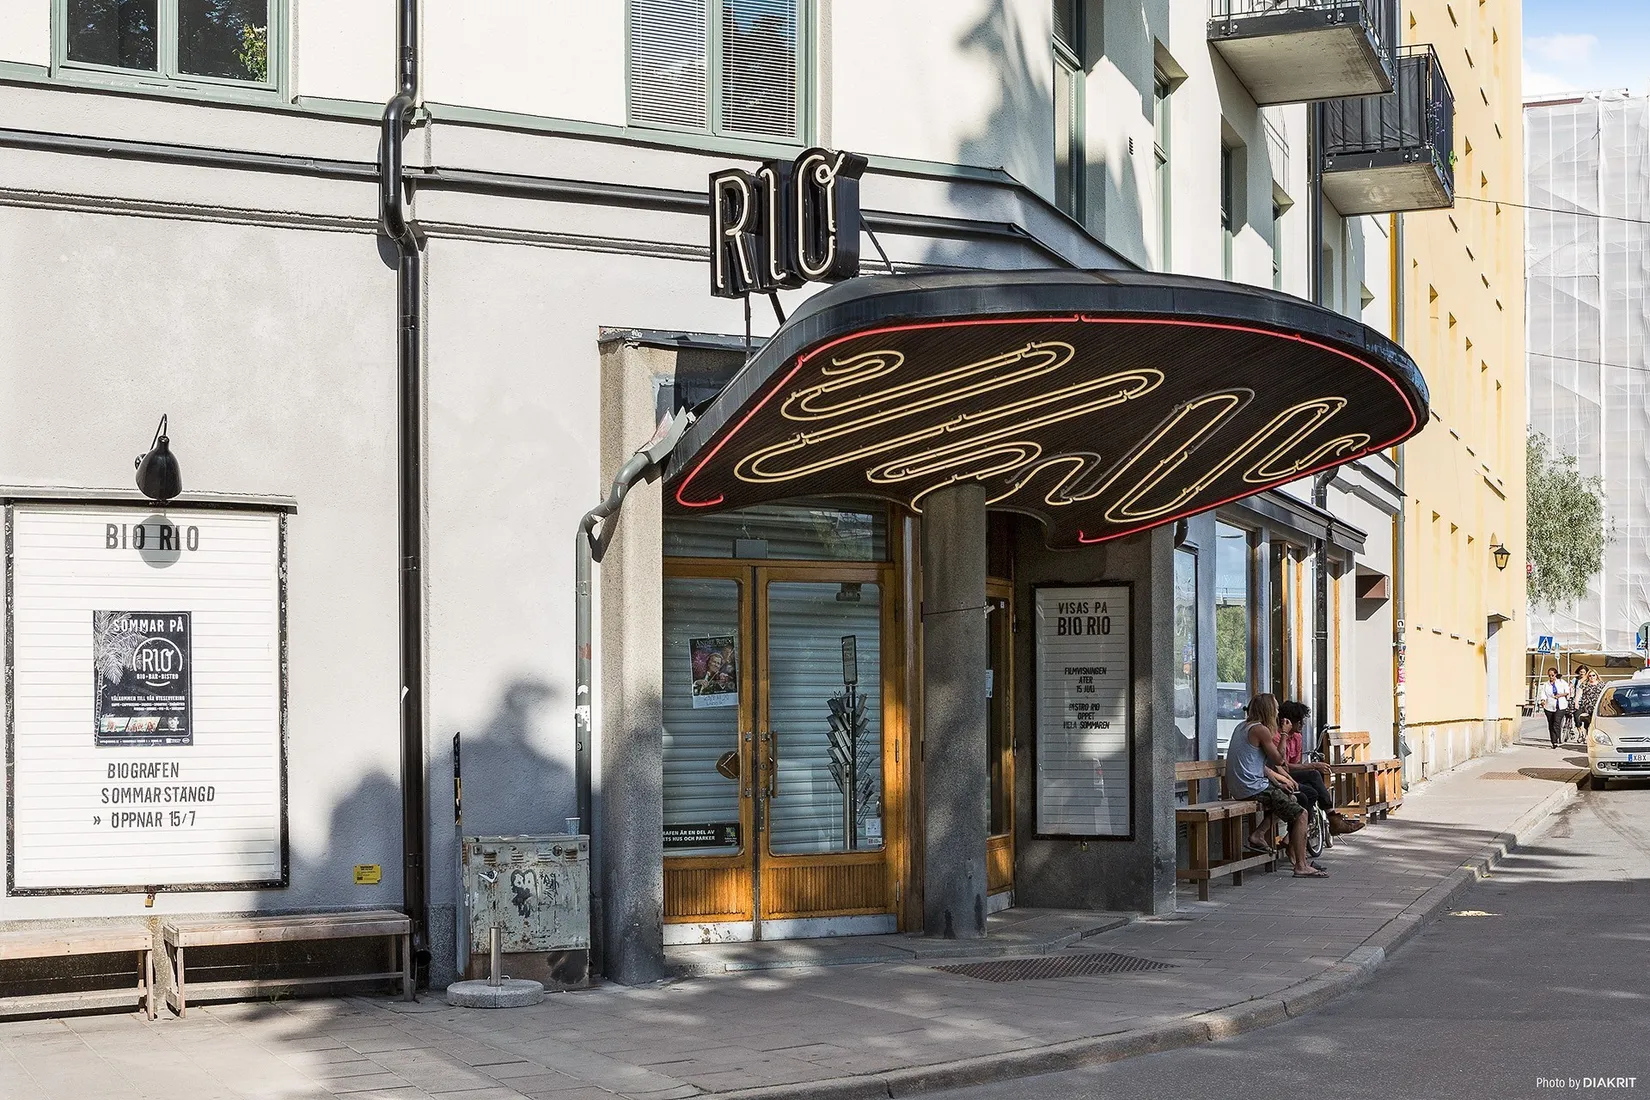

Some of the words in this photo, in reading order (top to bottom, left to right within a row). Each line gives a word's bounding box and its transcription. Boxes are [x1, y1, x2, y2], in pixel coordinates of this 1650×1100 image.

[710, 148, 850, 297] RIO
[106, 524, 145, 550] BIO
[160, 524, 199, 551] RIO
[1058, 601, 1089, 614] VISAS
[113, 618, 164, 632] SOMMAR
[169, 616, 184, 632] PÅ
[1057, 616, 1083, 636] BIO
[1086, 616, 1111, 635] RIO
[142, 648, 175, 672] RIO
[107, 762, 179, 779] BIOGRAFEN
[111, 811, 163, 829] ÖPPNAR
[168, 810, 196, 827] 15/7
